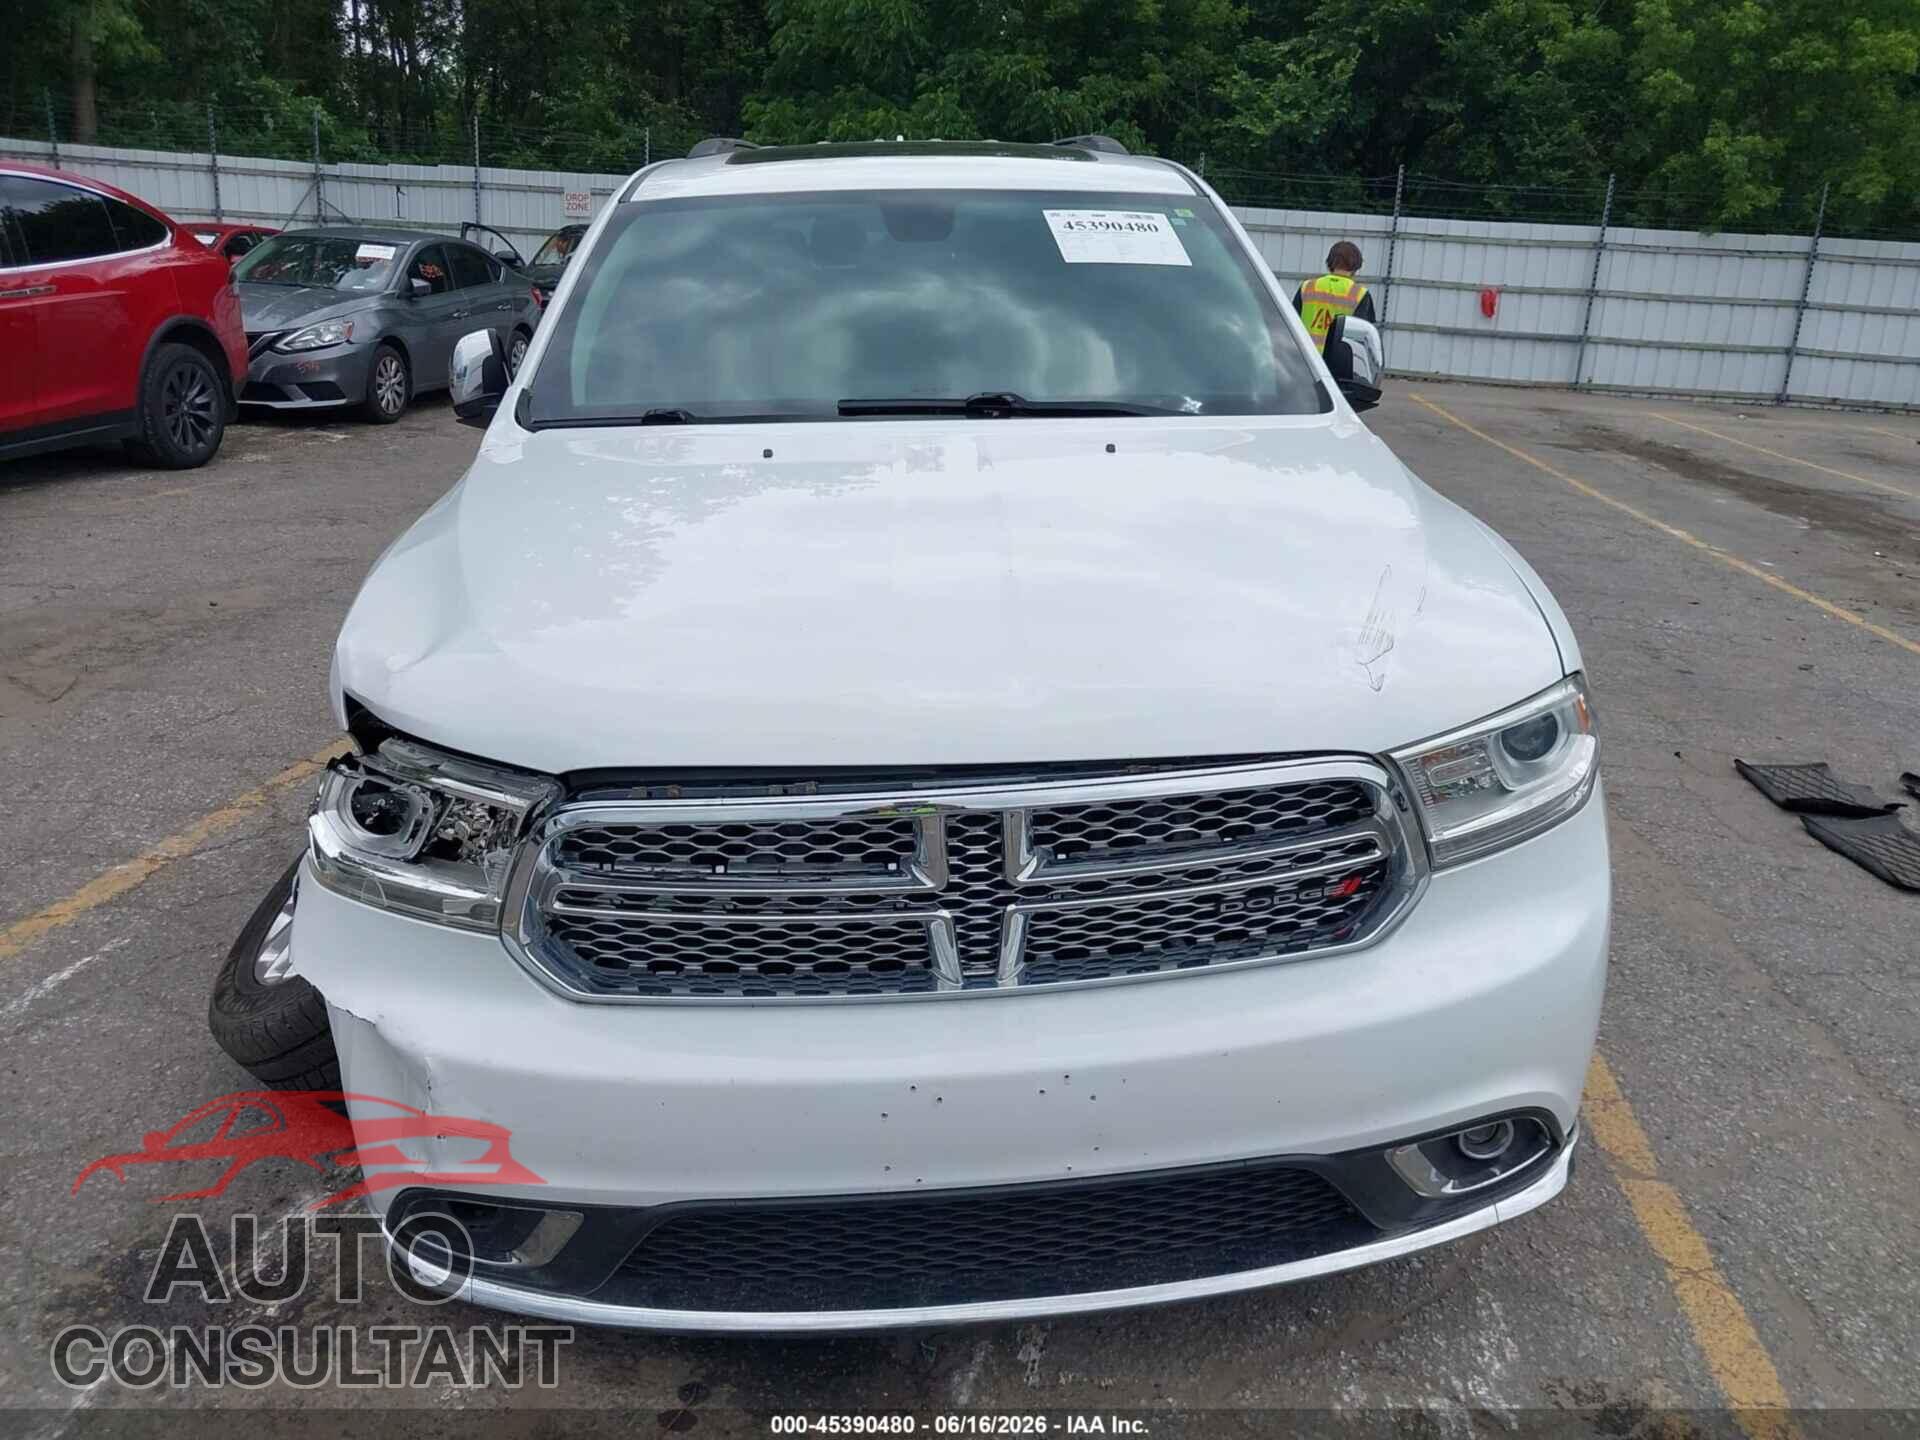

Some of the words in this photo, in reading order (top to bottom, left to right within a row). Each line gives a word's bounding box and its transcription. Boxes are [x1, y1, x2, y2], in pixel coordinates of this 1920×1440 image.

[565, 193, 590, 201] DROP
[567, 202, 591, 210] ZONE
[1063, 220, 1159, 233] 45390480
[1220, 886, 1347, 913] DODGE
